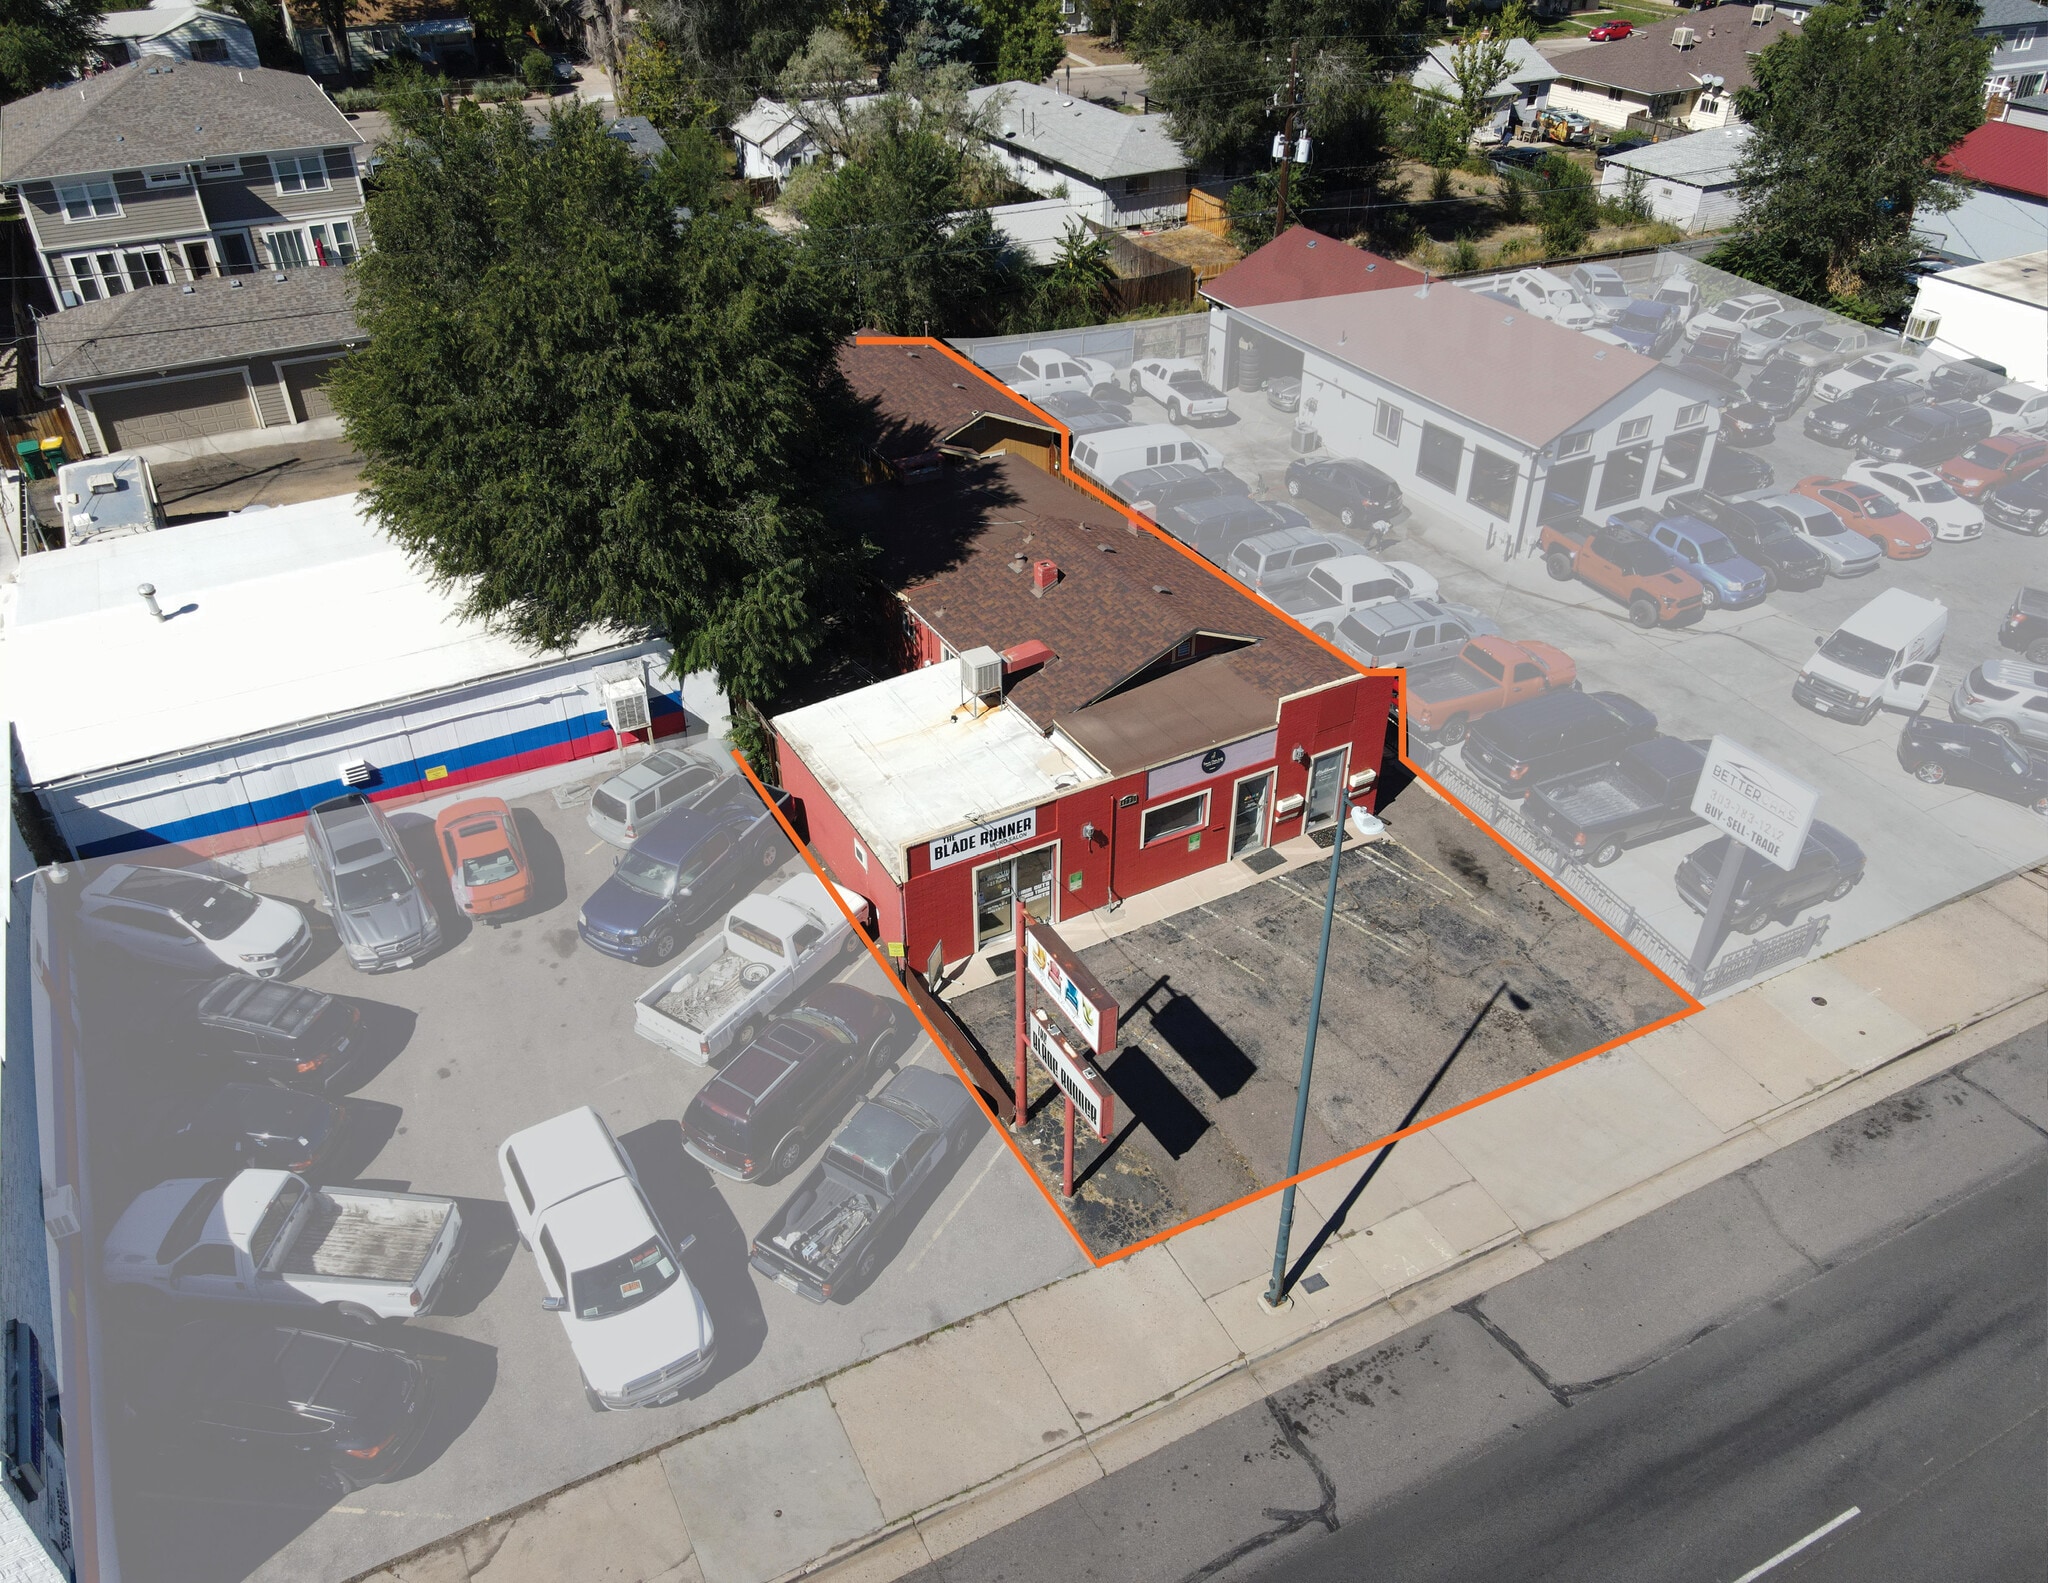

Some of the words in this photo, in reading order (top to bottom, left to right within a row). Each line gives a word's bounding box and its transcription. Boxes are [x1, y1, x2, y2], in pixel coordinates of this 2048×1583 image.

[935, 835, 976, 861] BLADE
[981, 817, 1032, 846] RUNNER
[943, 835, 956, 844] THE
